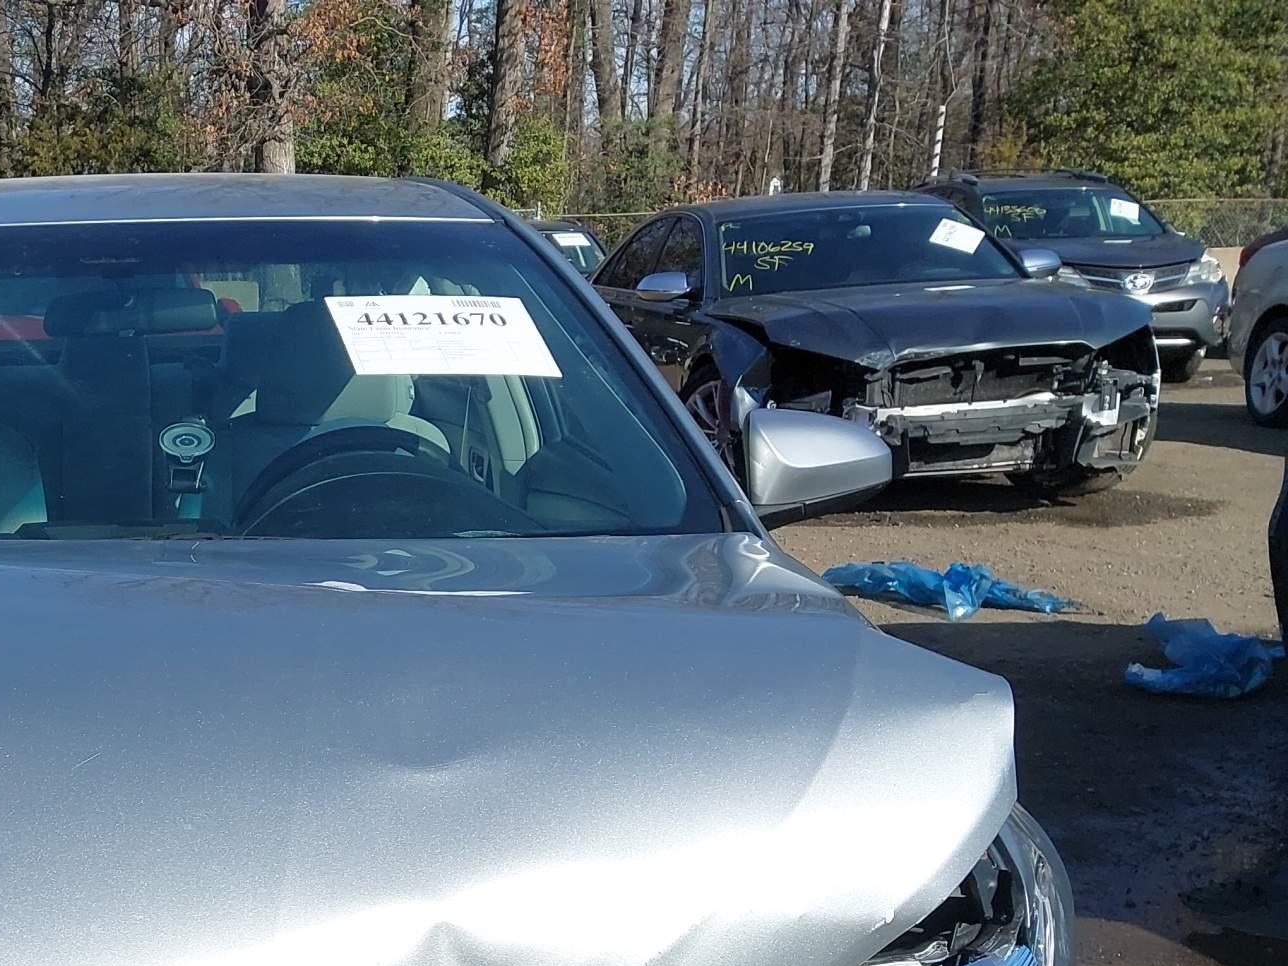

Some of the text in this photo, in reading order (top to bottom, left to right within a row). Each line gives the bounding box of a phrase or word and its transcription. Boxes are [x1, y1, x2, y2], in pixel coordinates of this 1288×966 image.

[994, 224, 1013, 239] M
[721, 240, 815, 255] 44106259
[728, 273, 754, 292] M
[357, 311, 508, 326] 44121670
